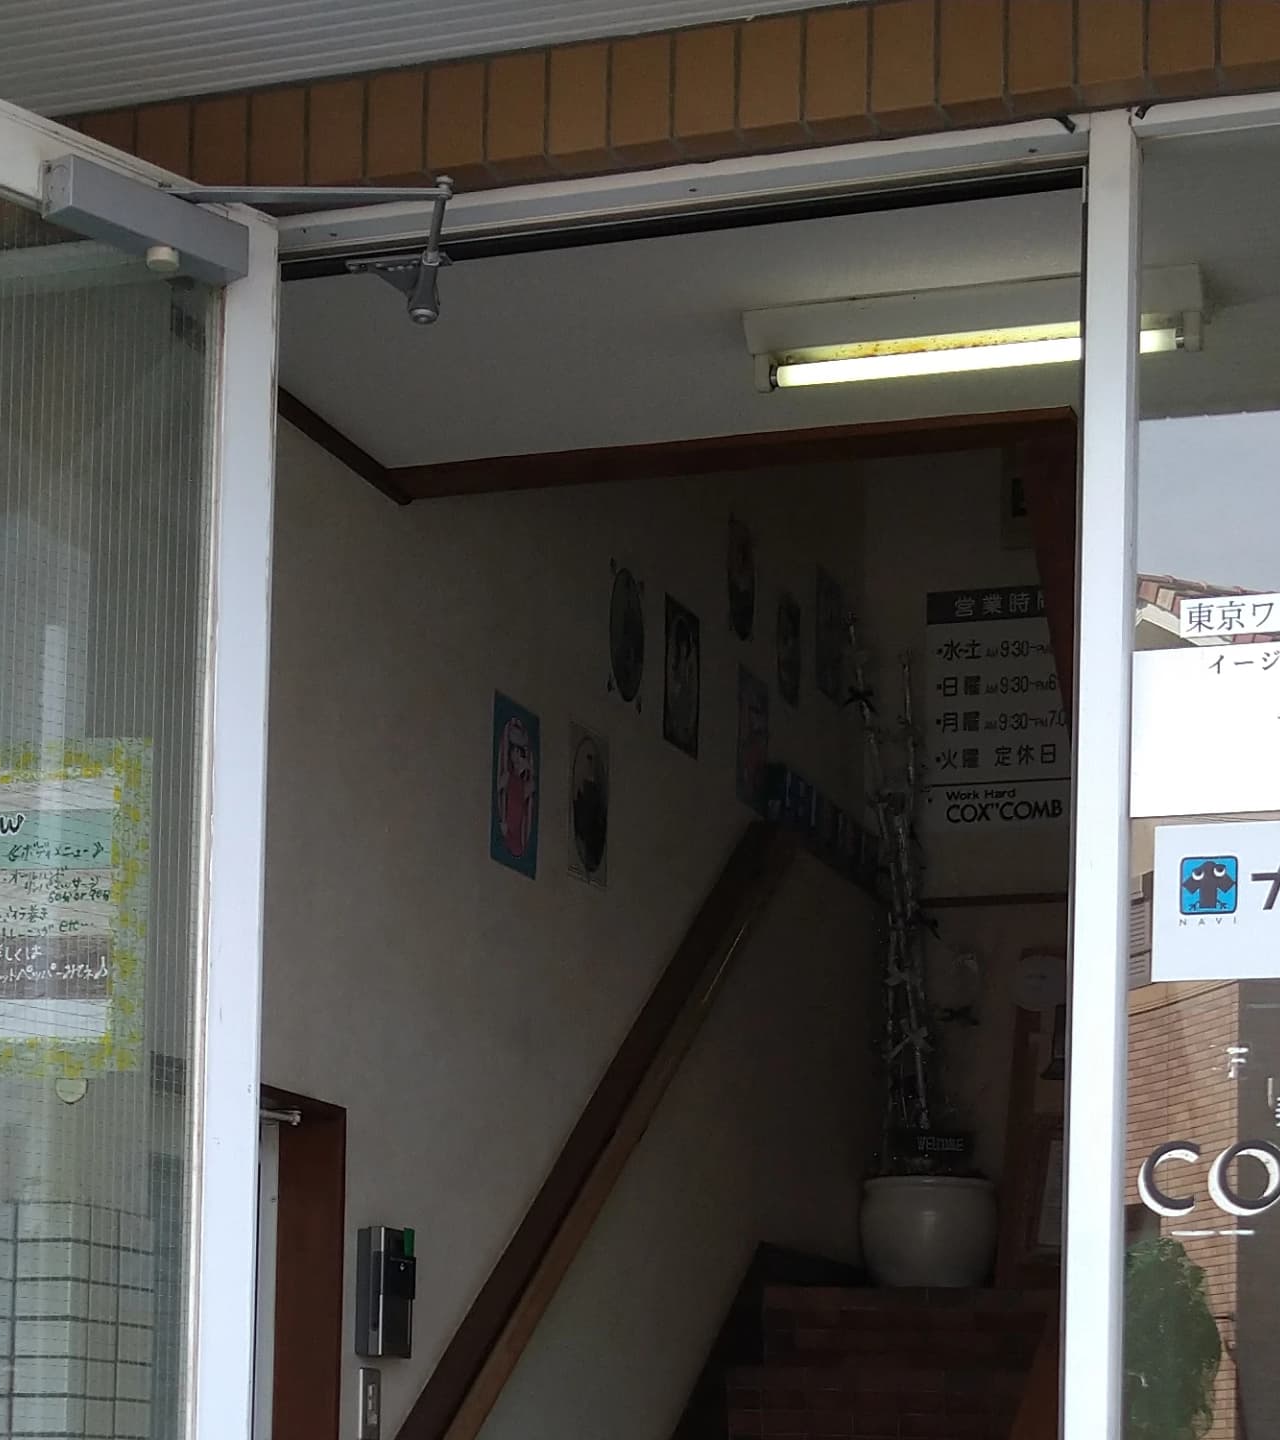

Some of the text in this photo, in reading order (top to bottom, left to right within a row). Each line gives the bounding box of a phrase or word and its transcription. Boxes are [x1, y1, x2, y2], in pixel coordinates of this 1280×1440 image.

[942, 675, 981, 697] 日曜
[942, 711, 980, 733] 月曜
[940, 743, 1057, 770] 火曜 定休日
[945, 788, 1016, 801] Work Hard
[1179, 916, 1237, 926] NAVI
